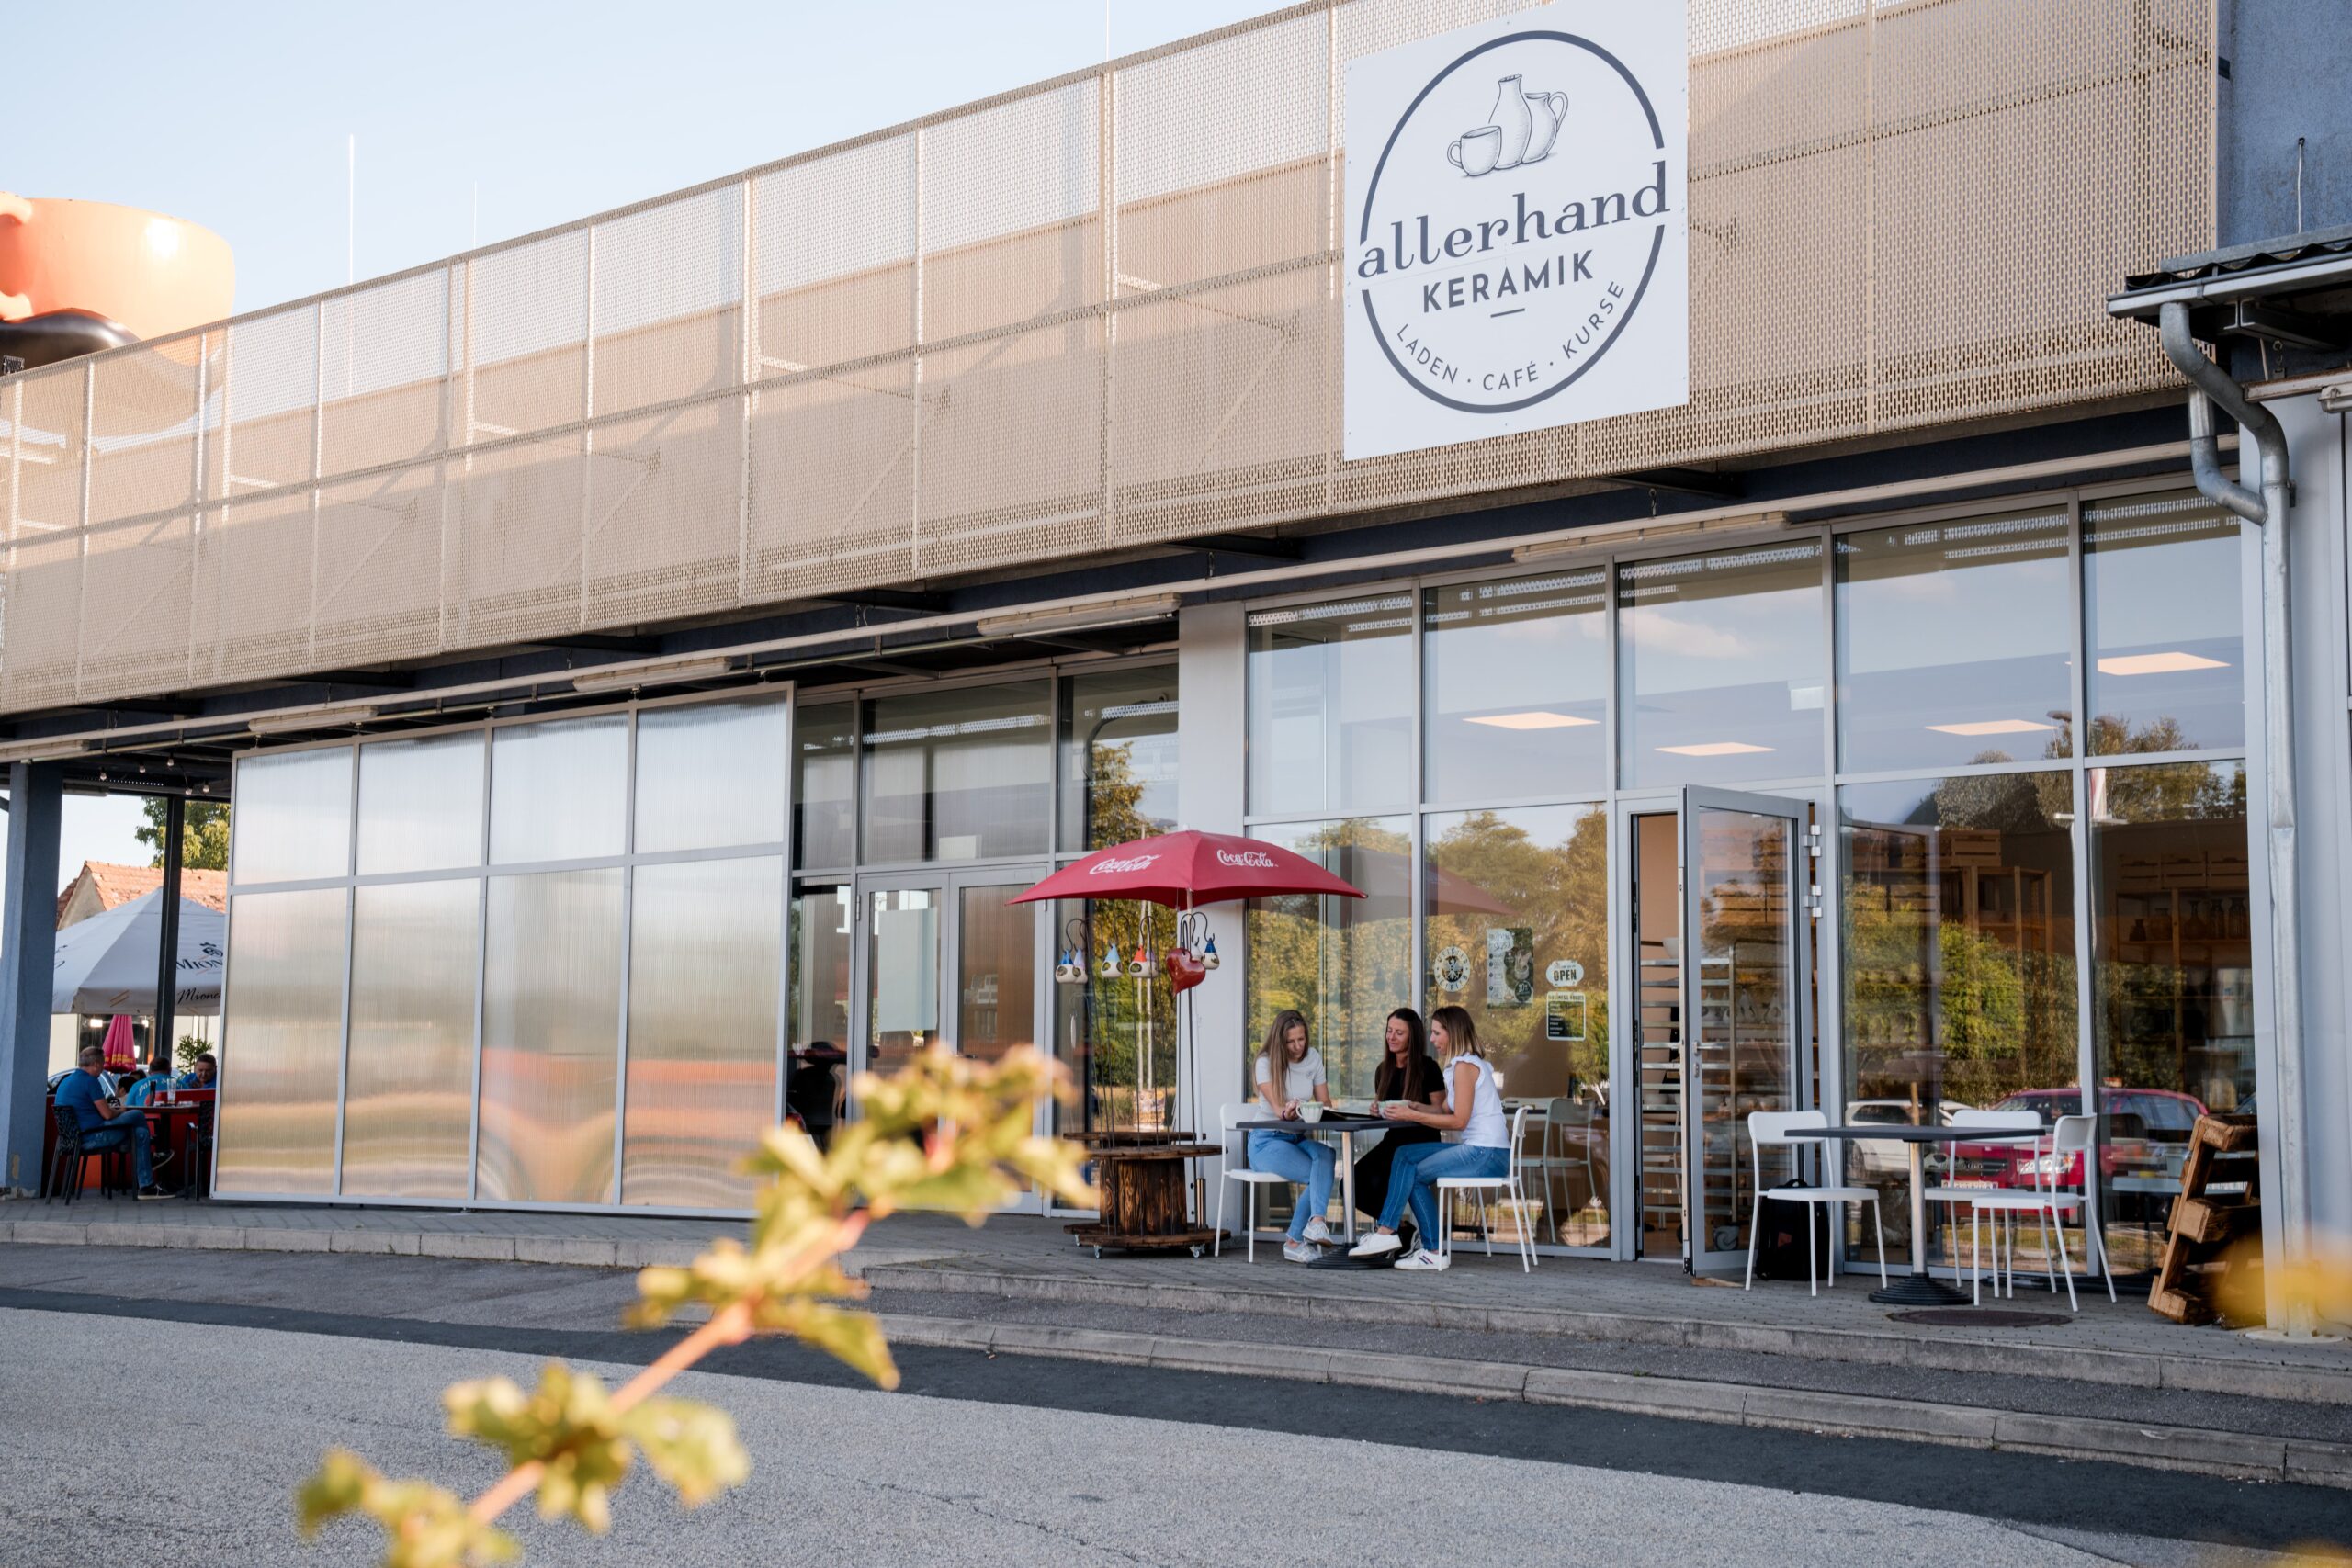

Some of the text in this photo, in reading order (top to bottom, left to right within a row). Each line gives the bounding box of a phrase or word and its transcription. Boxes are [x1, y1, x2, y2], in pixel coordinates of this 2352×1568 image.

[1357, 160, 1671, 279] allerhand
[1423, 249, 1593, 313] KERAMIK
[1396, 280, 1624, 391] LADEN CAFÉ KURSE
[1216, 849, 1274, 868] Coca-Cola
[177, 987, 221, 1005] Mione
[1553, 969, 1577, 982] OPEN
